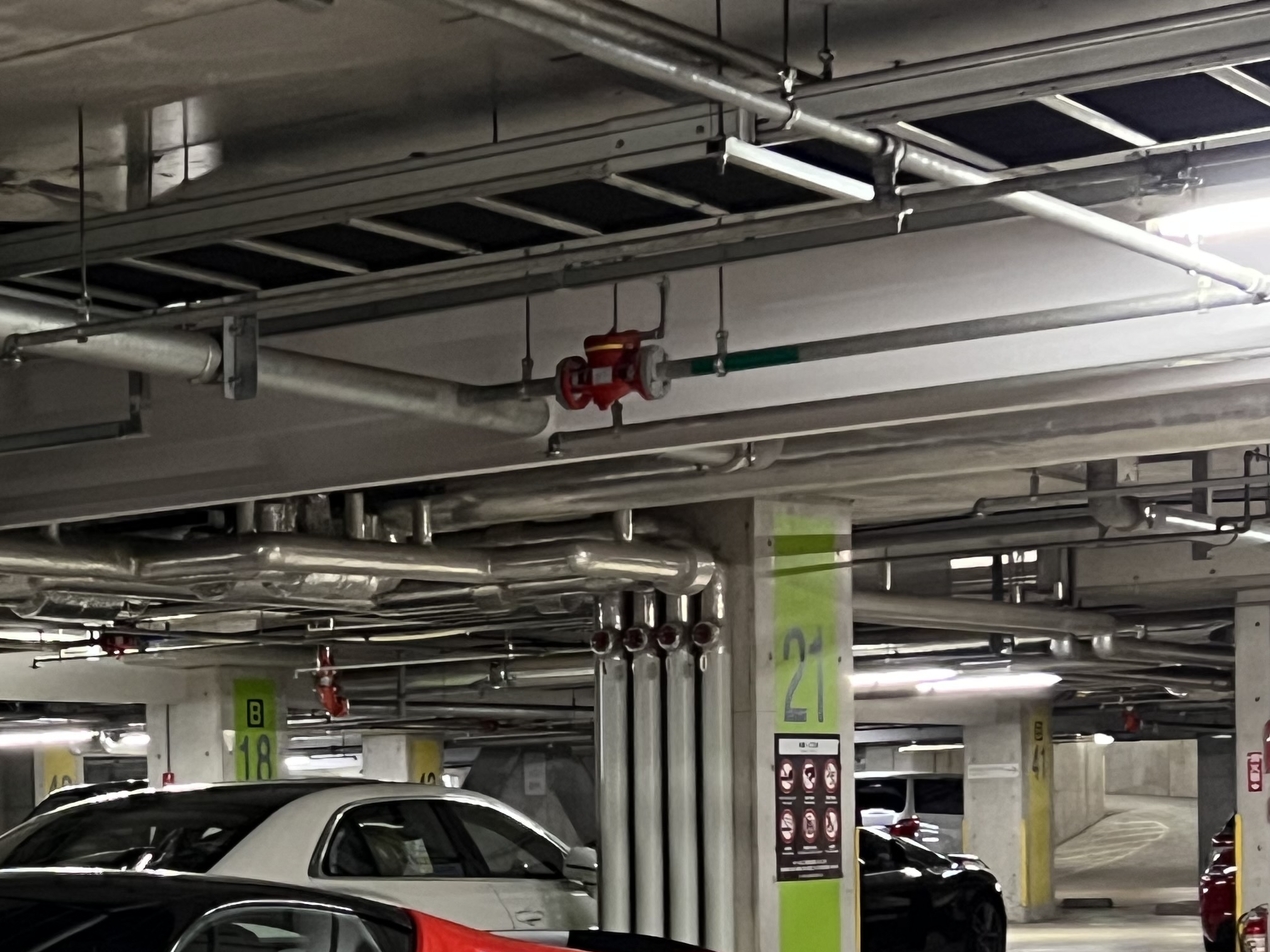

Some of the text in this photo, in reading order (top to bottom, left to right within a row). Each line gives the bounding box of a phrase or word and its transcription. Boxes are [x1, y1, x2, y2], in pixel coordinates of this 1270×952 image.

[783, 626, 824, 723] 21
[248, 700, 262, 727] B
[239, 734, 272, 780] 18
